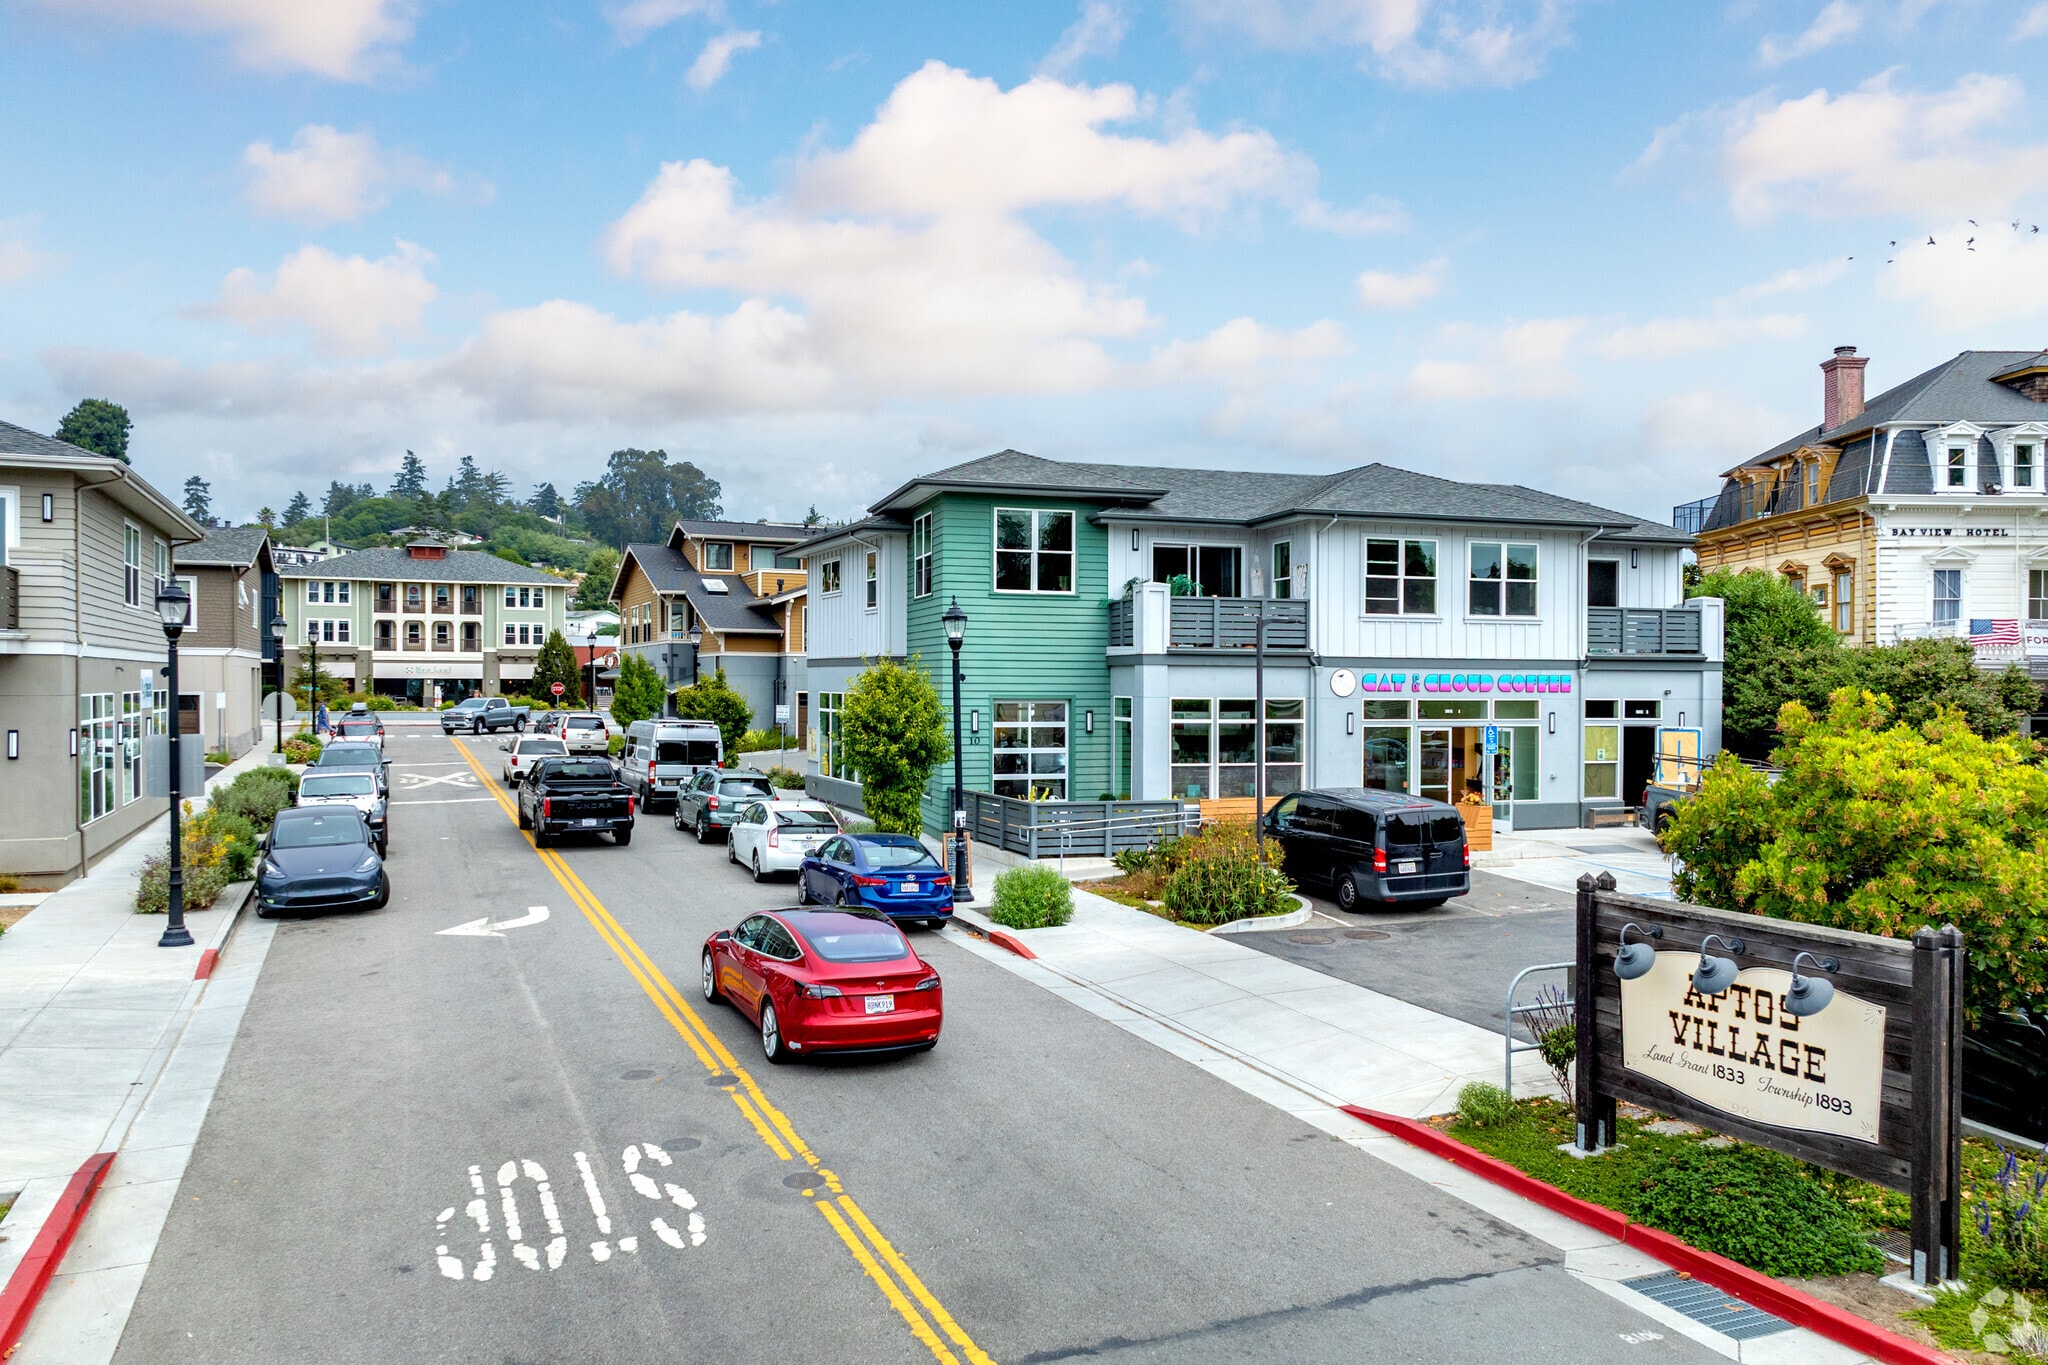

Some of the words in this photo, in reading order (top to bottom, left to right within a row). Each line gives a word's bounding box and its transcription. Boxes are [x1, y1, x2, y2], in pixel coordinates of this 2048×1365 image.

[1891, 528, 1916, 537] BAY
[1920, 528, 1953, 537] VIEW
[1966, 528, 2009, 537] HOTEL
[1362, 673, 1406, 692] CAT
[1411, 673, 1421, 692] &
[1424, 673, 1494, 693] CLOUD
[1498, 673, 1572, 693] COFFEE
[969, 736, 981, 746] 10
[1668, 1010, 1827, 1084] VILLAGE
[1642, 1044, 1673, 1065] Land
[1675, 1051, 1711, 1075] Grant
[1712, 1063, 1745, 1085] 1833
[1757, 1076, 1813, 1108] Township
[1815, 1092, 1853, 1116] 1893
[435, 1143, 707, 1282] STOP
